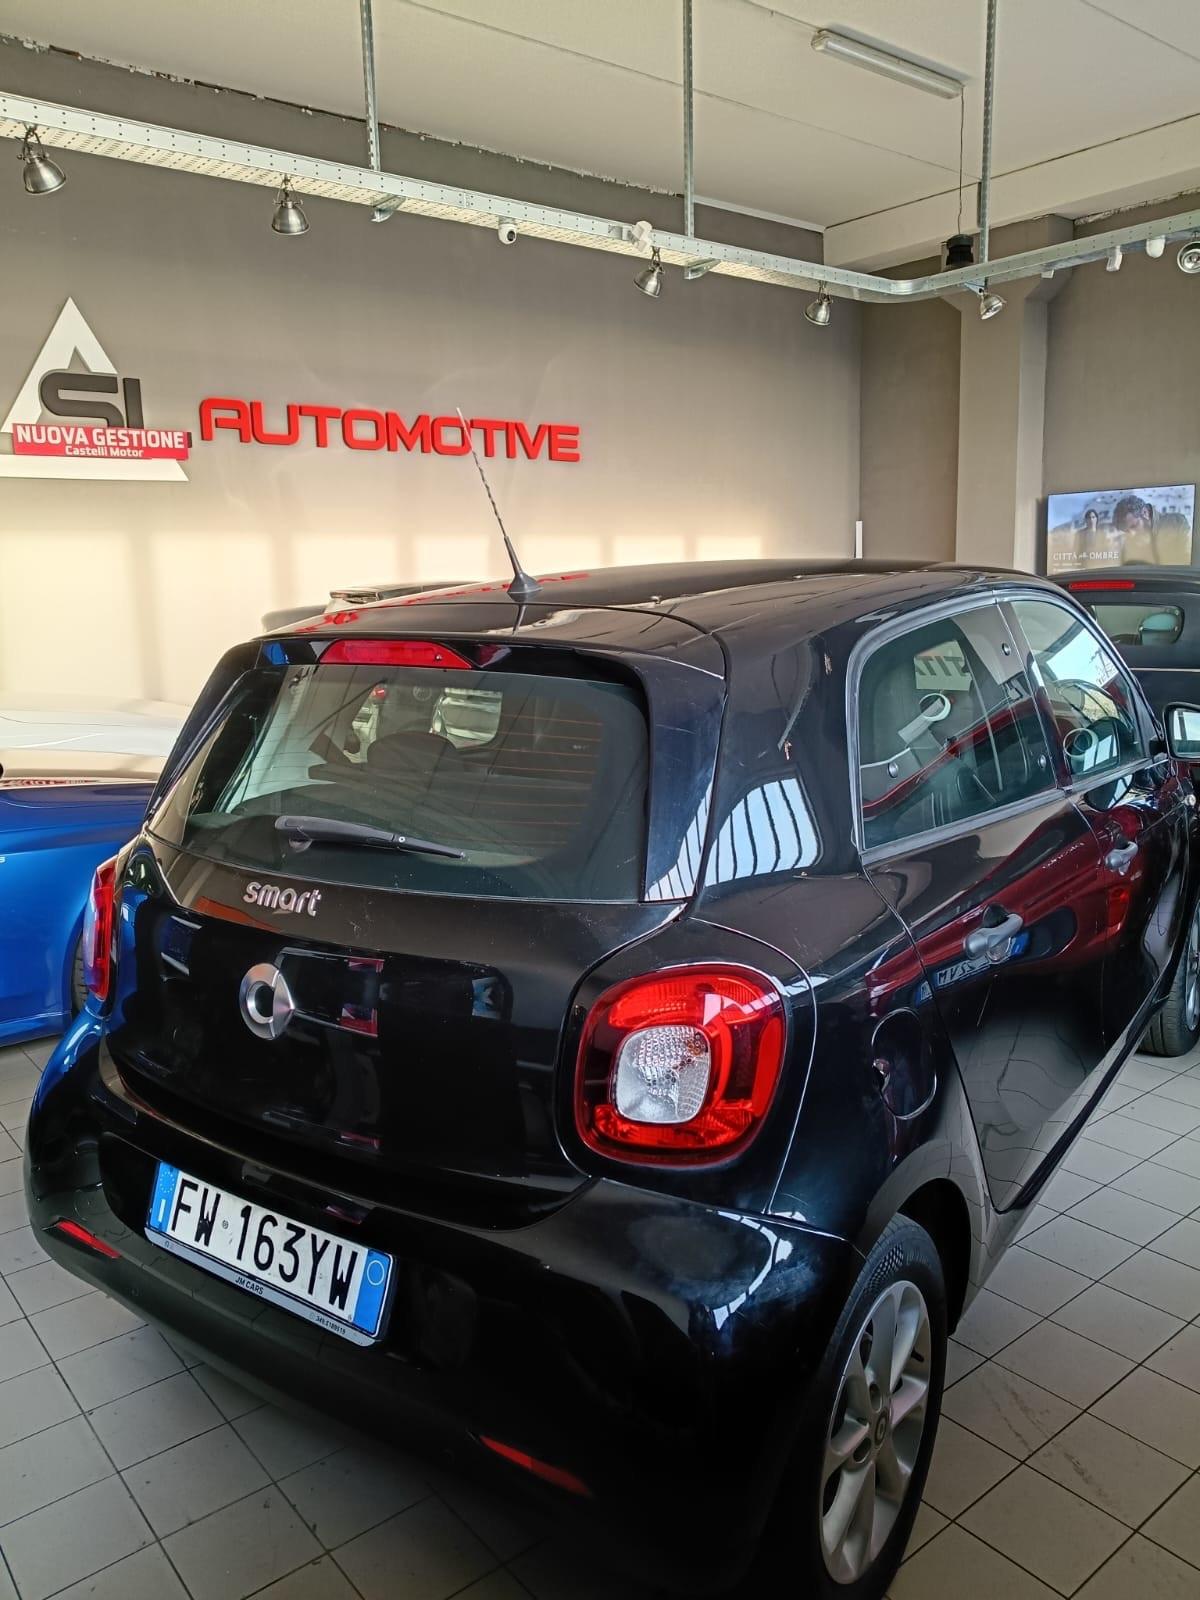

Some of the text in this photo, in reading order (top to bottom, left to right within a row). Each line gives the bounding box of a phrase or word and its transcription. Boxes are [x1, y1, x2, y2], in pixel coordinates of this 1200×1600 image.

[16, 424, 185, 449] NUOVA GESTIONE
[199, 397, 580, 462] AUTOMOTIVE
[65, 445, 144, 458] Castelli Motor
[243, 881, 322, 917] smart
[171, 1178, 359, 1311] FW 163YW
[235, 1276, 264, 1295] JM CARS
